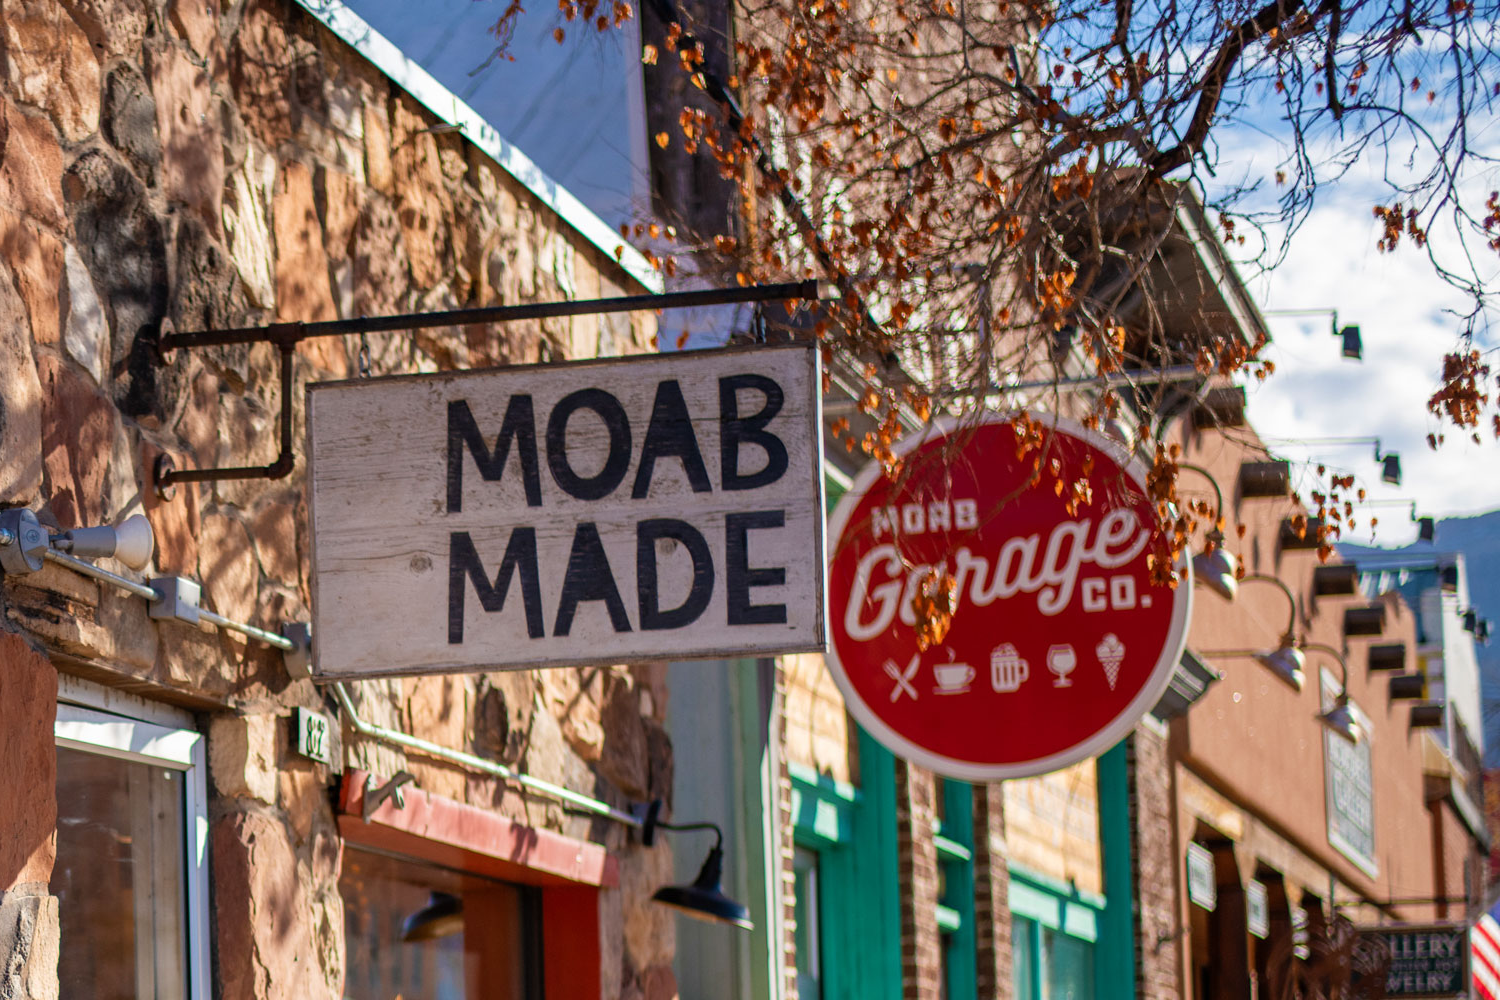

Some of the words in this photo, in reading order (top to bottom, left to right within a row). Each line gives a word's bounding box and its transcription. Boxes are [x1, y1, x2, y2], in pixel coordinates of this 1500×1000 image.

[446, 372, 790, 514] MOAB
[870, 498, 979, 539] MOAB
[447, 508, 789, 645] MADE
[1080, 574, 1153, 613] CO.
[1388, 933, 1461, 959] LLERY
